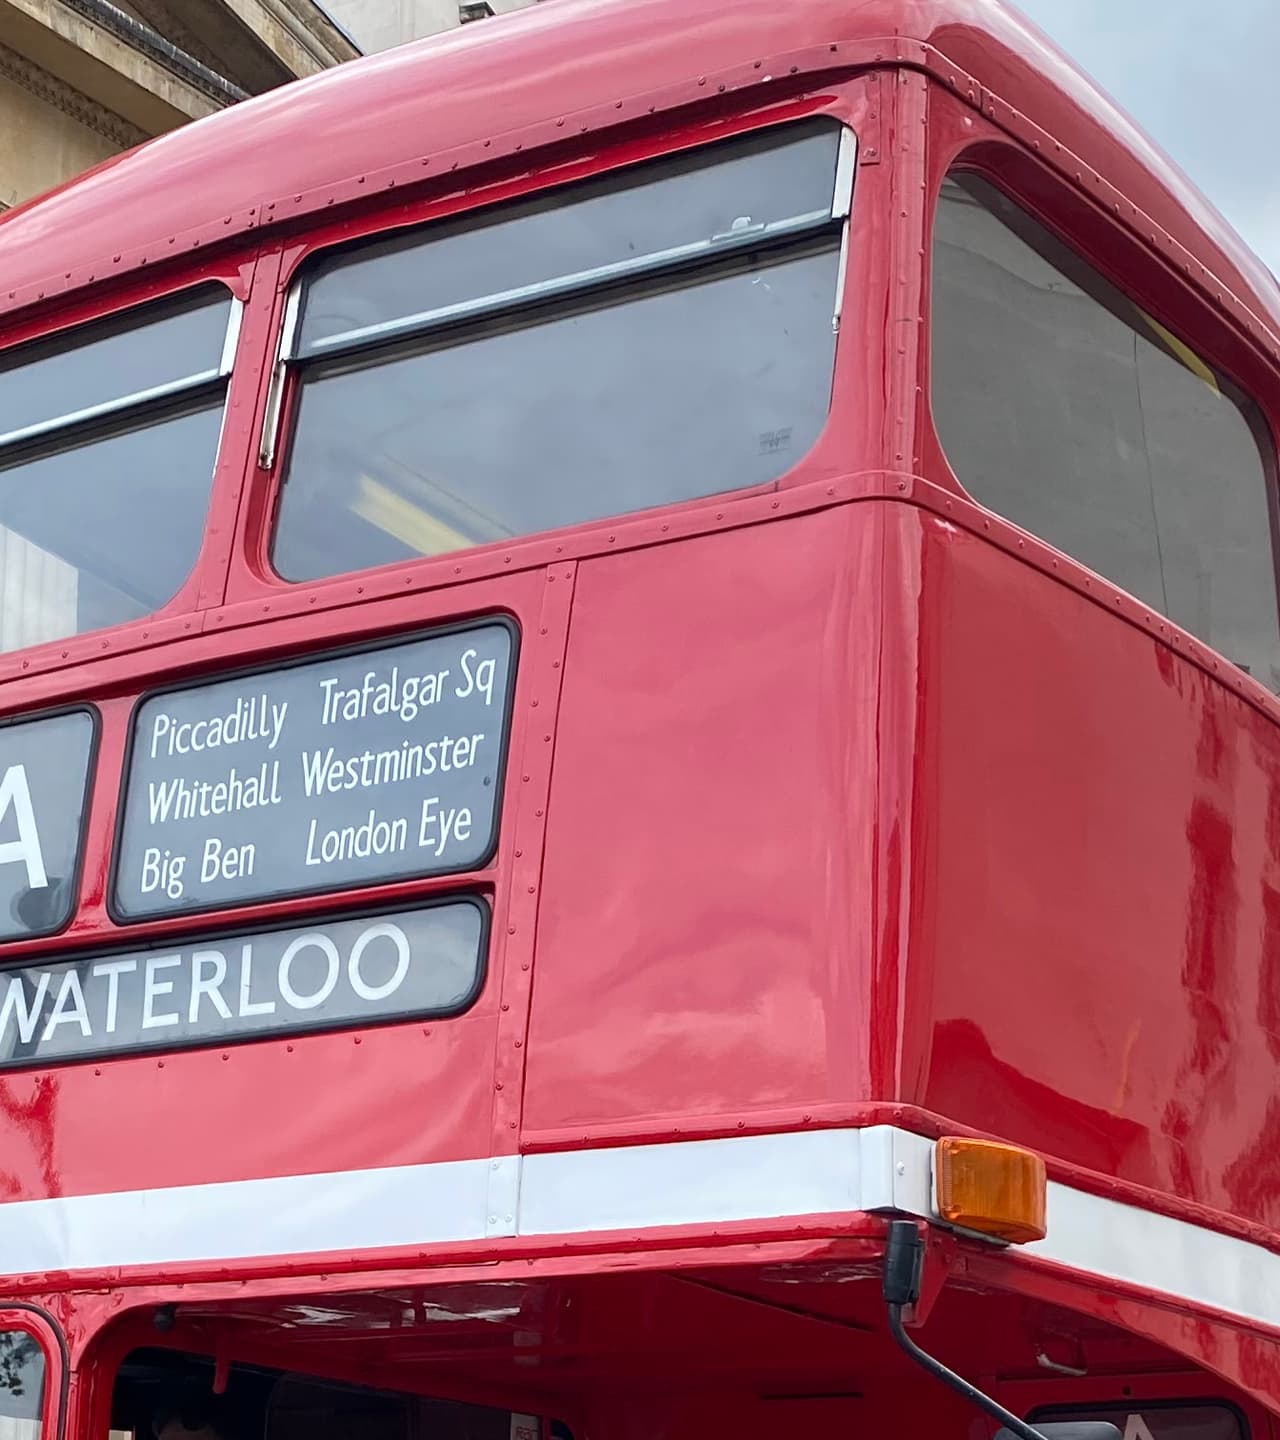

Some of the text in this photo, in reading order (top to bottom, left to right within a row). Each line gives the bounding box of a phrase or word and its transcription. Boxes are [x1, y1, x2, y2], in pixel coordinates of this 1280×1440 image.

[150, 648, 496, 759] Piccadilly Trafalgar Sq
[147, 732, 484, 825] Whitehall Westminster
[141, 797, 472, 900] Big Ben London Eye
